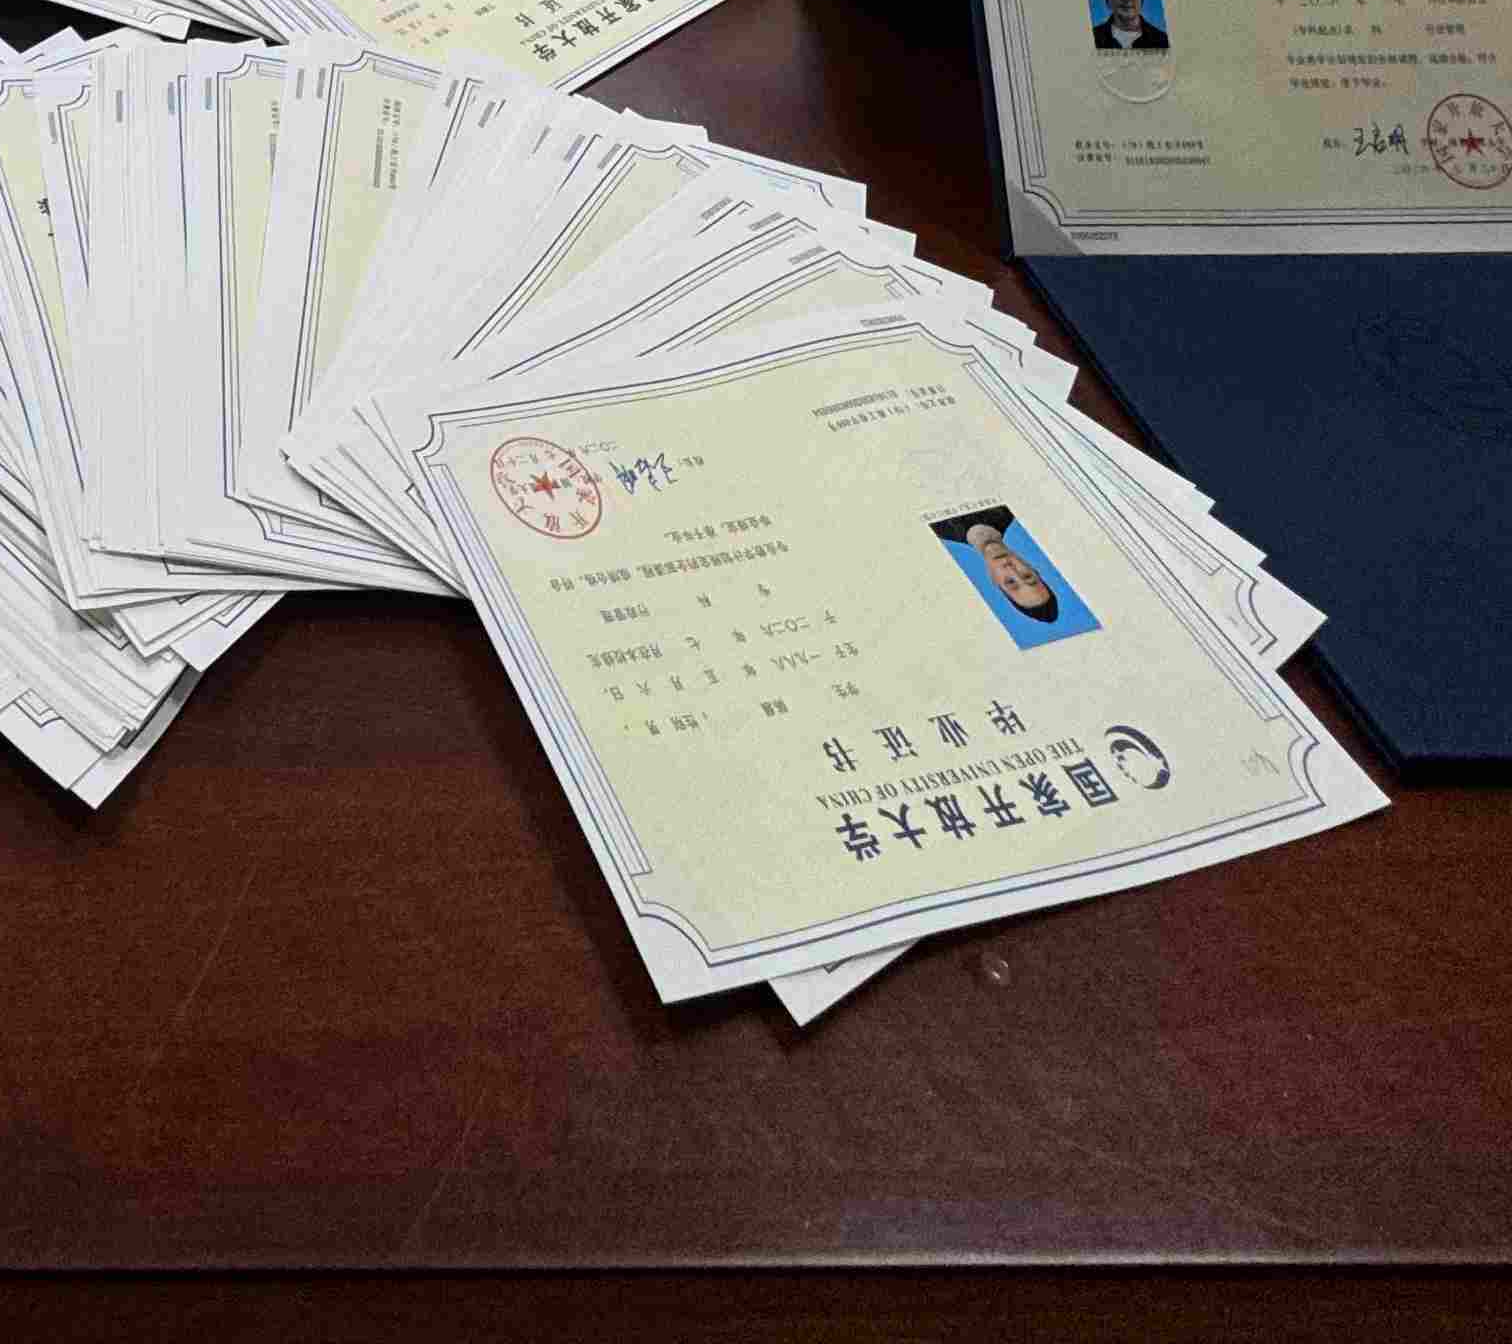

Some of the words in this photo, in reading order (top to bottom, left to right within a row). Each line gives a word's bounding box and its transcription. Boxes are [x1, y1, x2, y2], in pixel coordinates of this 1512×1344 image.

[821, 699, 1028, 774] 毕业证书
[1046, 735, 1085, 762] THE
[1000, 746, 1045, 772] OPEN
[901, 759, 1000, 792] UNIVERSITY
[815, 786, 872, 811] CHINA
[874, 781, 899, 799] OF
[834, 757, 1119, 863] 国家开放大学
